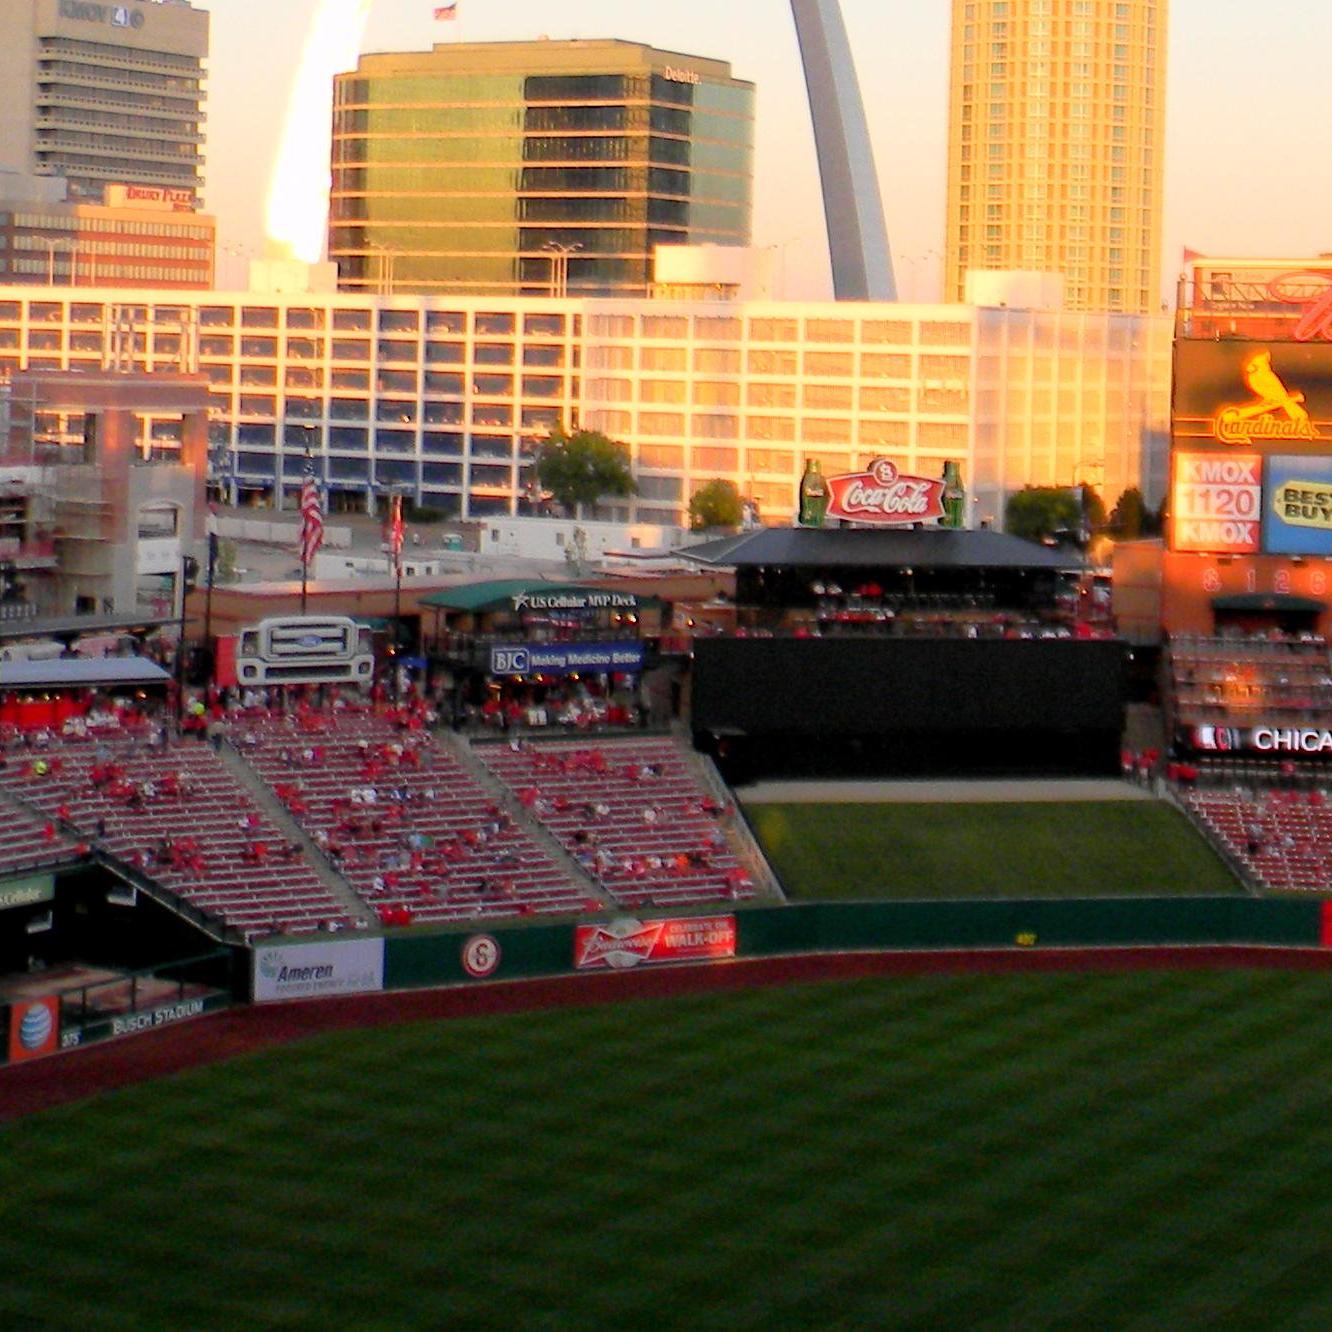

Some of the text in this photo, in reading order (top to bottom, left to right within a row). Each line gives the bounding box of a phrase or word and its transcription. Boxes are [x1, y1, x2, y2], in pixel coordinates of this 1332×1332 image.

[1217, 408, 1320, 445] Cardinals
[1186, 460, 1255, 484] KMOX
[1184, 489, 1255, 516] 1120
[1185, 522, 1255, 545] KMOX
[1274, 570, 1292, 594] 2
[496, 652, 525, 672] BJC
[277, 963, 334, 983] Ameren
[112, 1000, 205, 1036] BUSCH STADIUM
